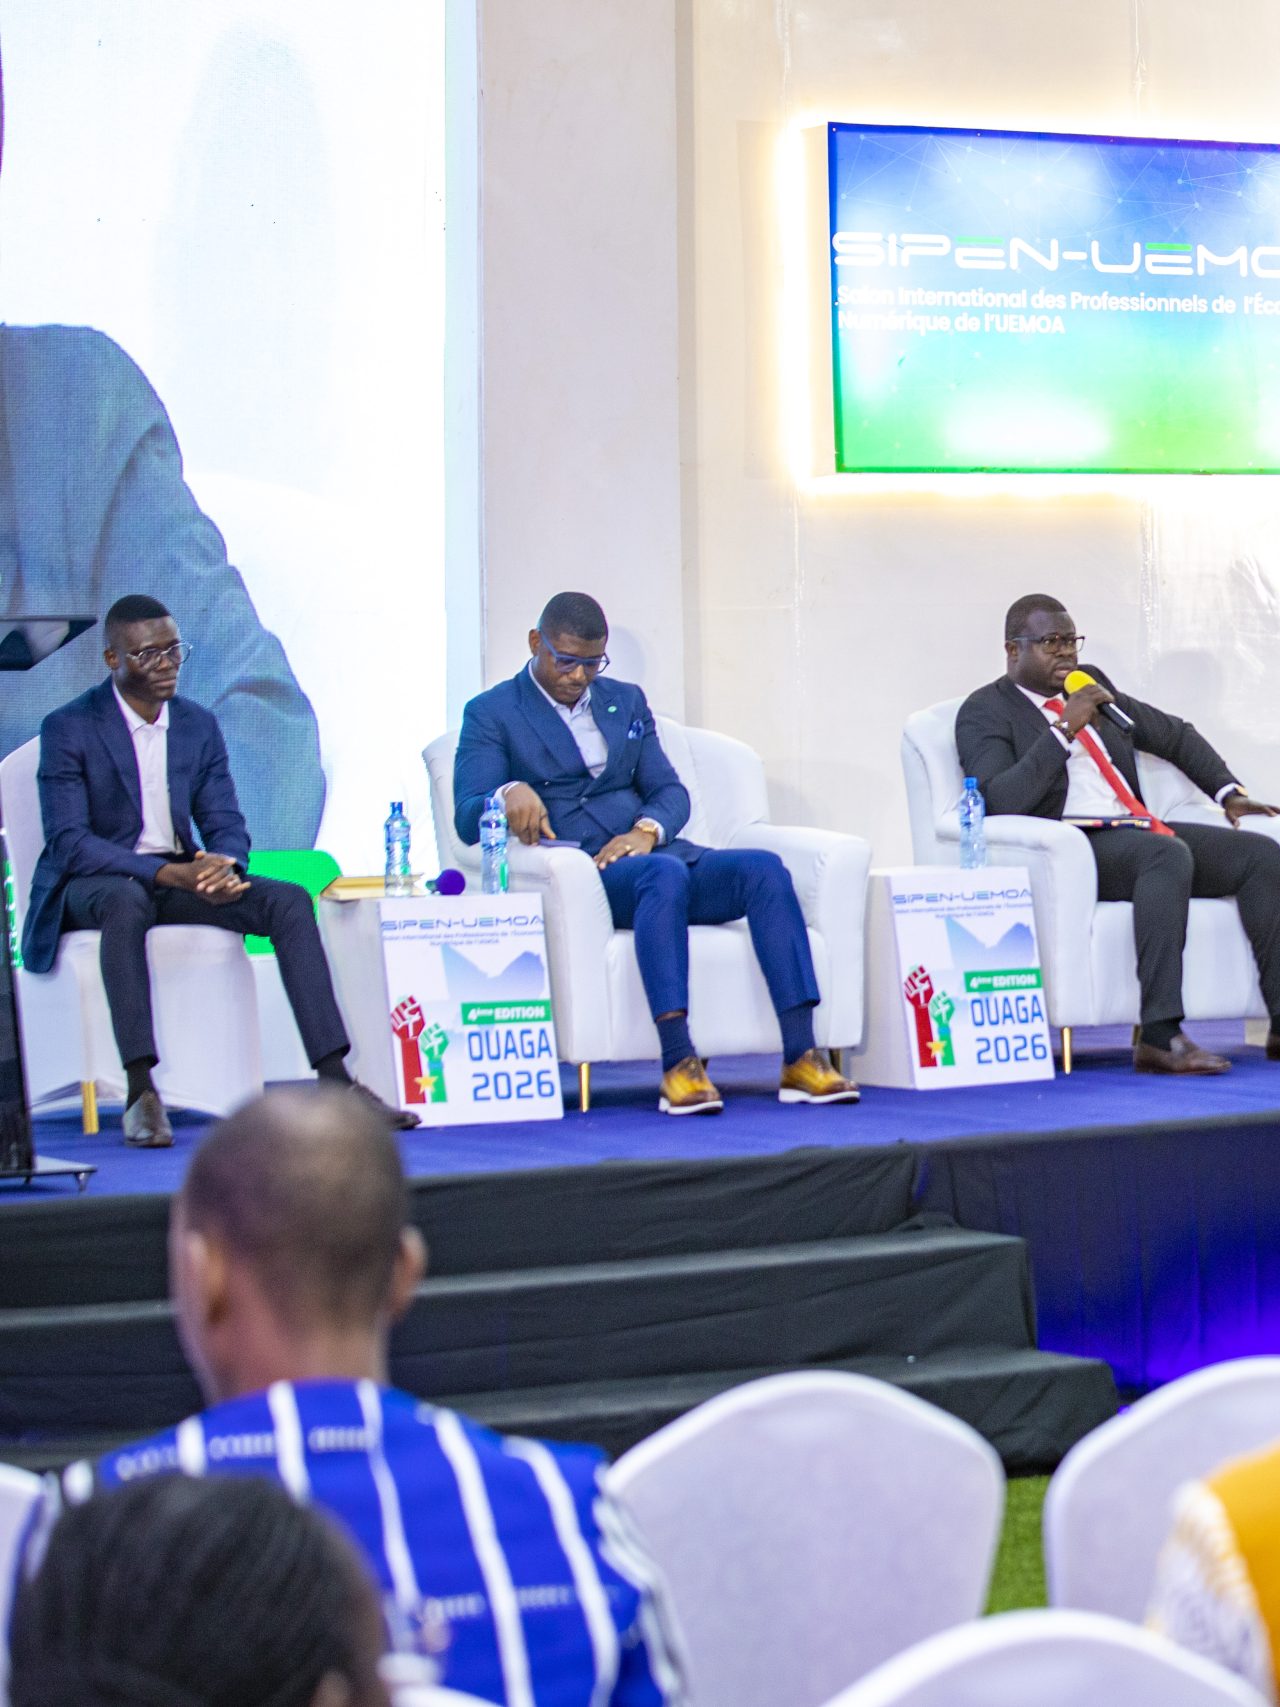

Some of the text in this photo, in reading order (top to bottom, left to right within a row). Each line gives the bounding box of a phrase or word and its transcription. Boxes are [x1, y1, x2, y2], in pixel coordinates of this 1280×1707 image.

[836, 285, 894, 305] Salon
[898, 286, 1027, 308] International
[1031, 289, 1067, 309] des
[1070, 291, 1209, 314] Professionnels
[1211, 295, 1237, 314] de
[954, 312, 981, 332] de
[984, 312, 1066, 334] l'UEMOA
[494, 1005, 546, 1020] EDITION
[971, 994, 1044, 1026] OUAGA
[468, 1028, 553, 1061] OUAGA
[976, 1033, 1047, 1064] 2026
[472, 1069, 555, 1101] 2026
